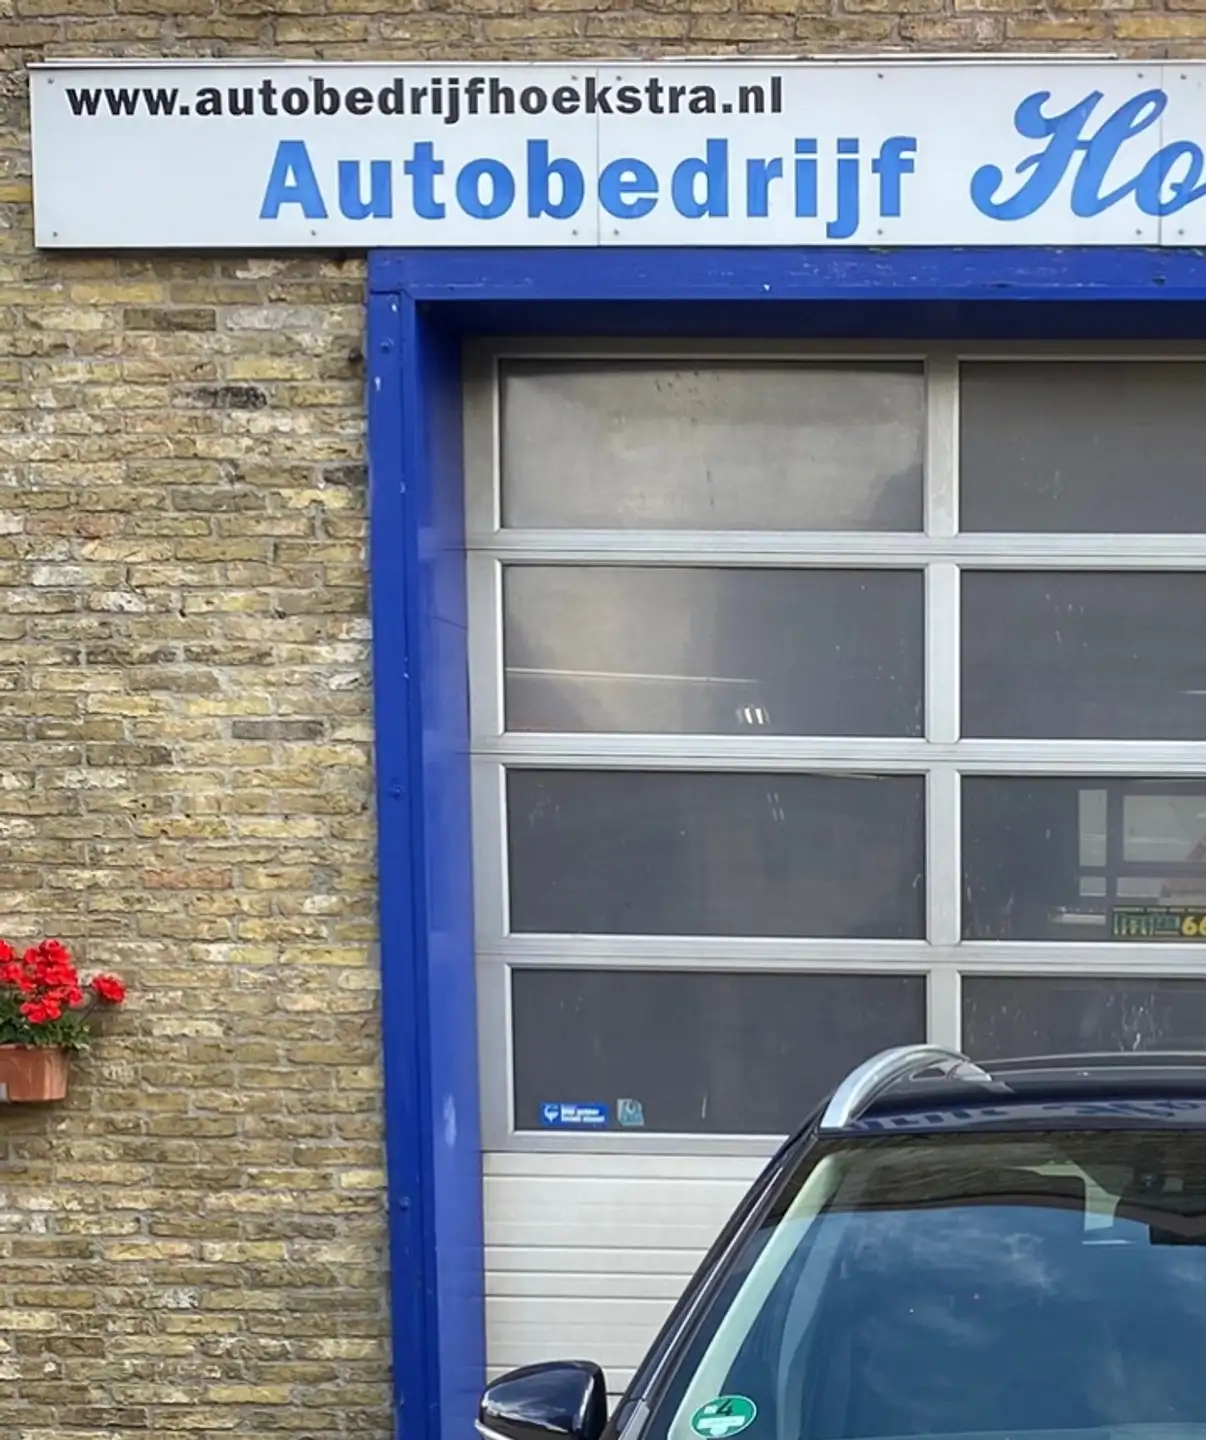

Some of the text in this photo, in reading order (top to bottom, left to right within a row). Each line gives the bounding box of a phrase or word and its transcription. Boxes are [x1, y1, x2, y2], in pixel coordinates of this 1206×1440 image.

[66, 77, 782, 124] www.autobedrijfhoekstra.nl
[260, 136, 916, 239] Autobedrijf
[716, 1399, 734, 1417] 4
